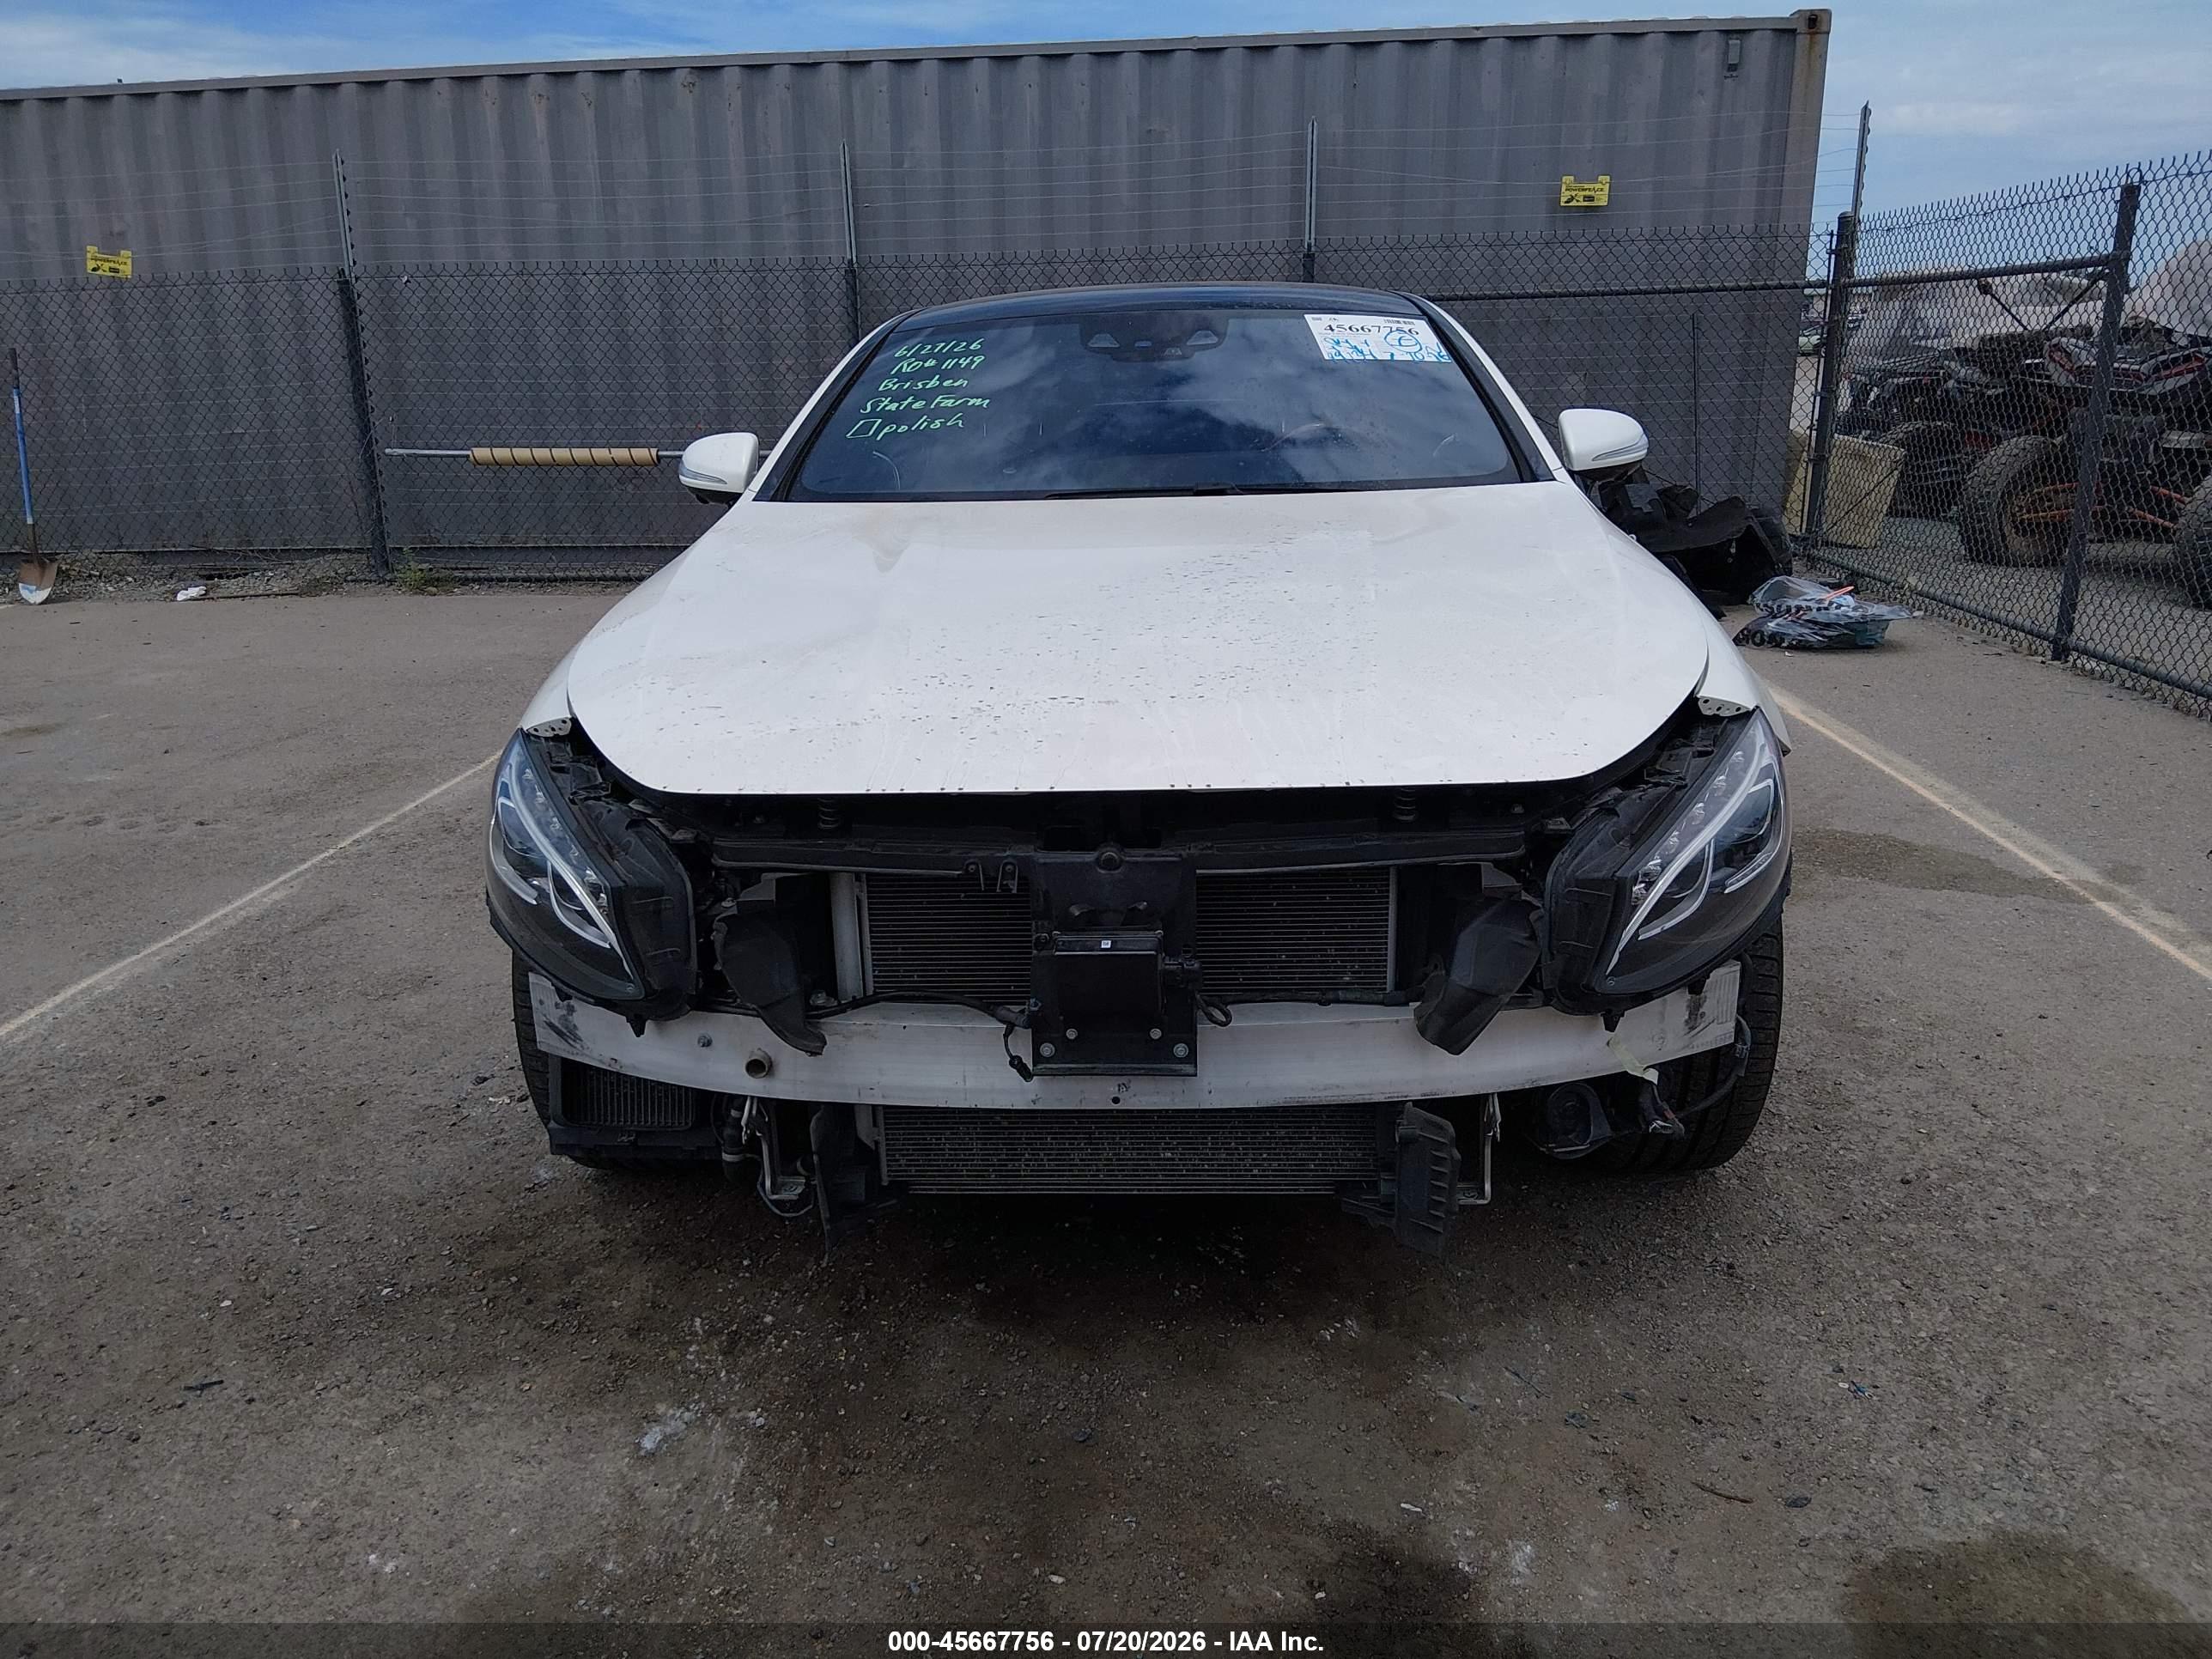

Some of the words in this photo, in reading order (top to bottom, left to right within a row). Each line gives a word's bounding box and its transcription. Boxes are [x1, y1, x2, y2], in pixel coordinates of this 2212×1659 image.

[1324, 324, 1419, 336] 45667756
[894, 338, 985, 357] 6/27/26
[941, 356, 986, 370] 1149
[876, 413, 964, 441] polish
